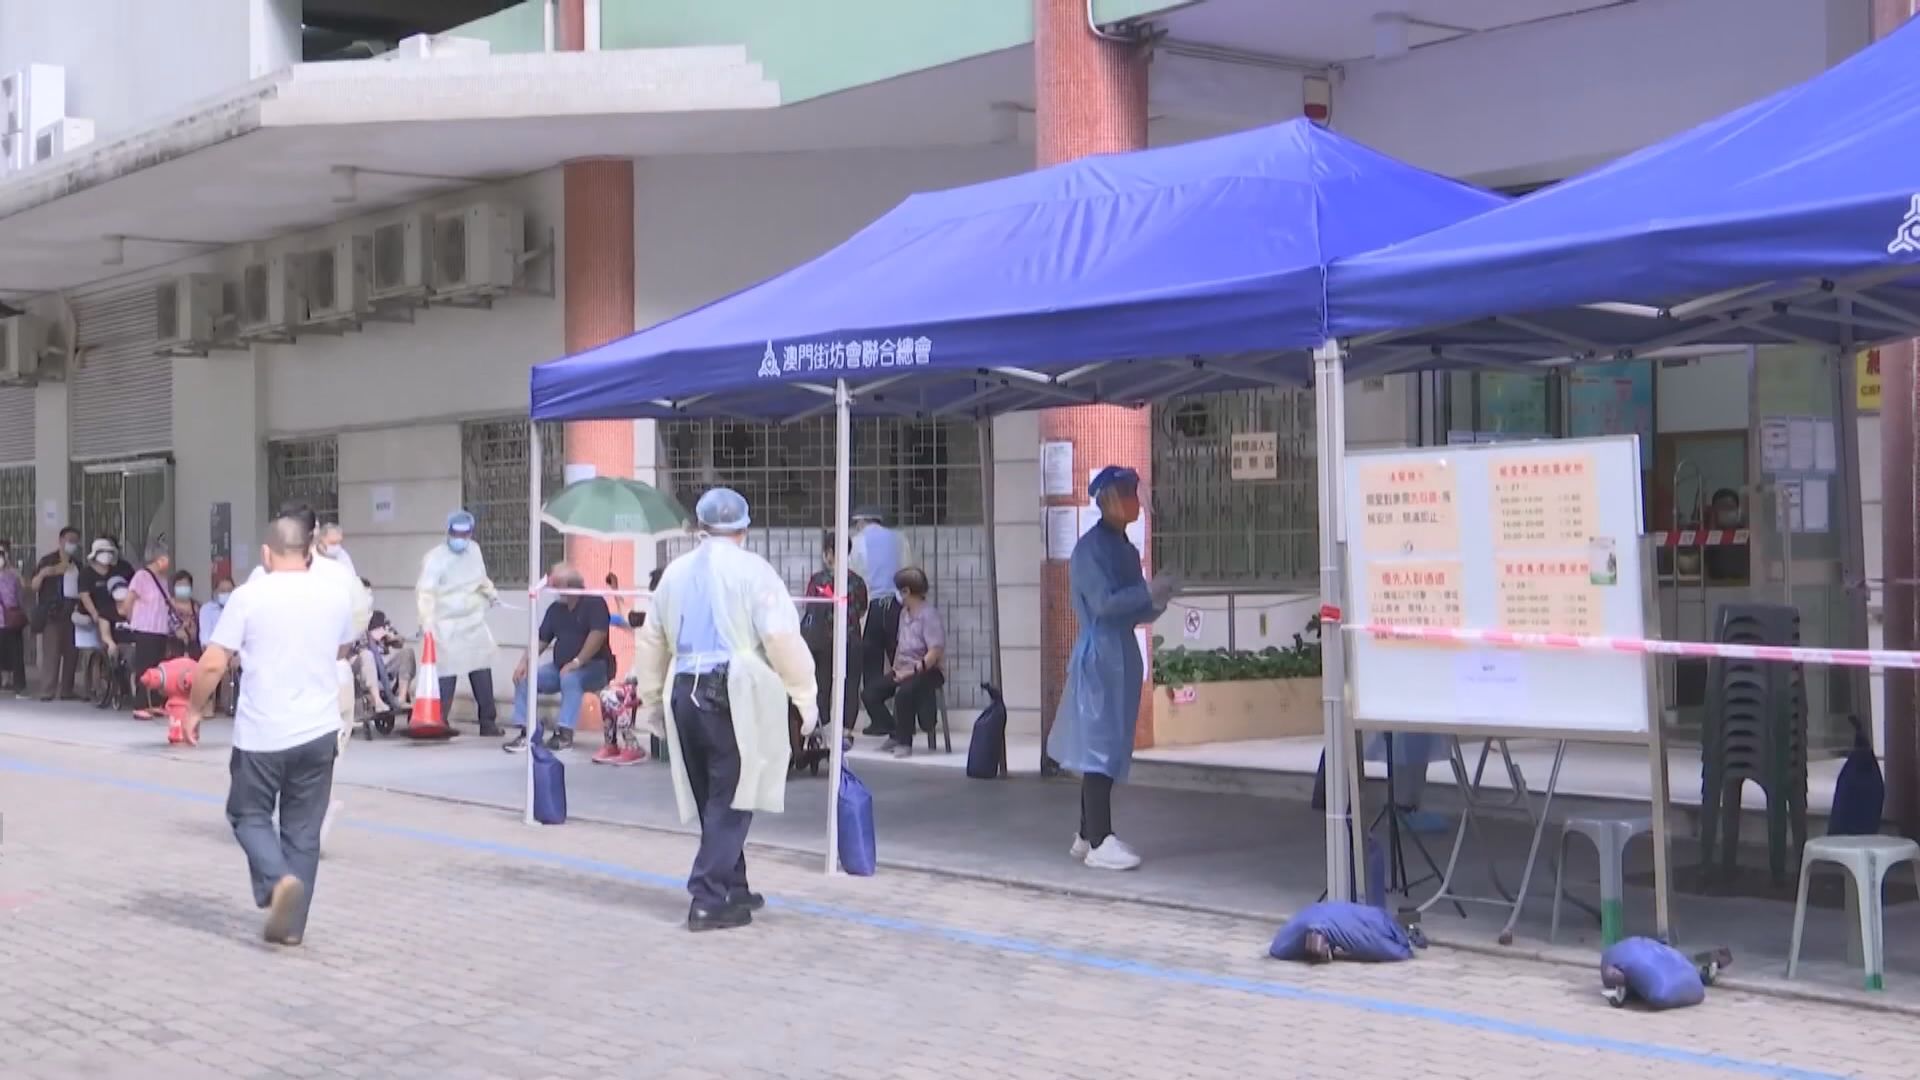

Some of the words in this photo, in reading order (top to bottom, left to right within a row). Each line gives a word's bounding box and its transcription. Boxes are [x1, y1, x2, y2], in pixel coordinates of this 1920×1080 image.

[782, 335, 932, 372] 澳門街坊會聯合總會
